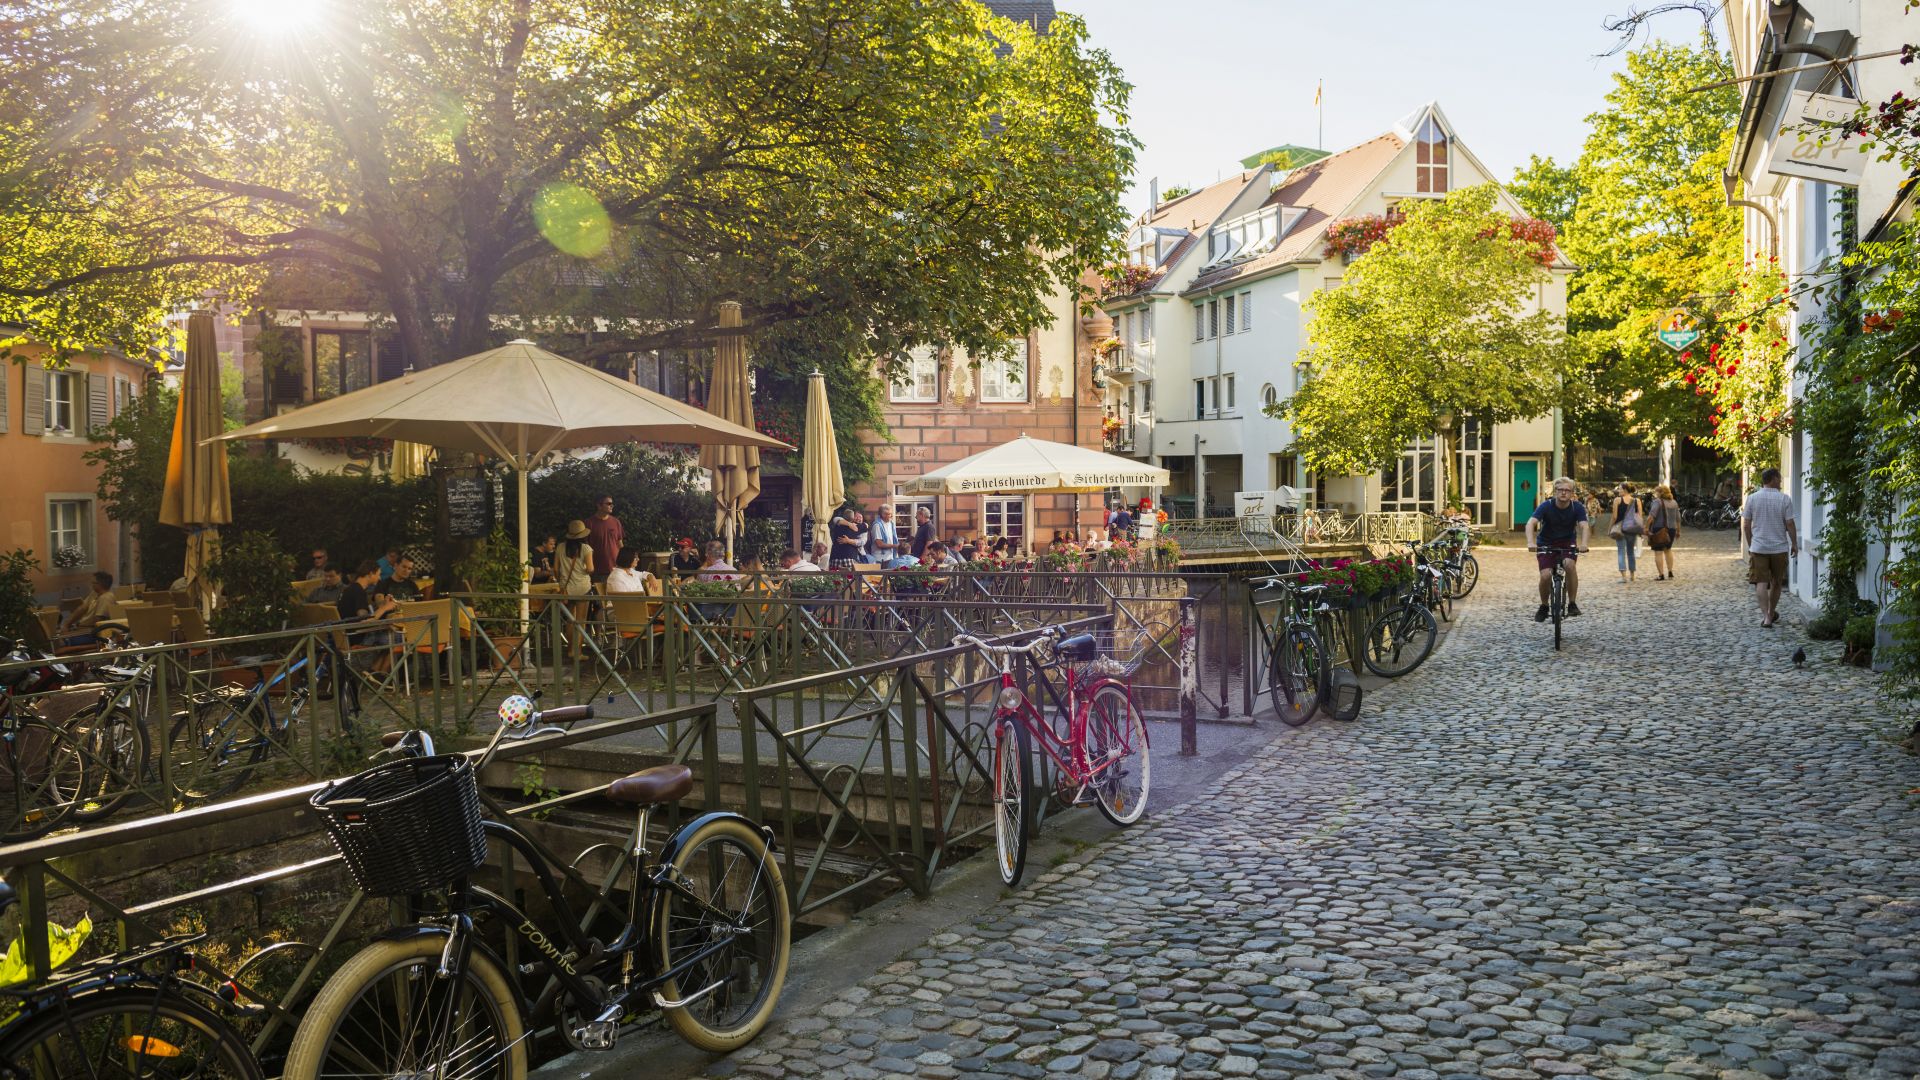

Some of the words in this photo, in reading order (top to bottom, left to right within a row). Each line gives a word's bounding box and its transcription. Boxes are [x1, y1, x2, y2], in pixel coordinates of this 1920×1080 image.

[1791, 139, 1854, 159] art
[961, 475, 1047, 490] Sichelschmiede
[1073, 474, 1156, 485] Sichelschmiede
[1244, 500, 1264, 514] art
[518, 920, 577, 976] townie
